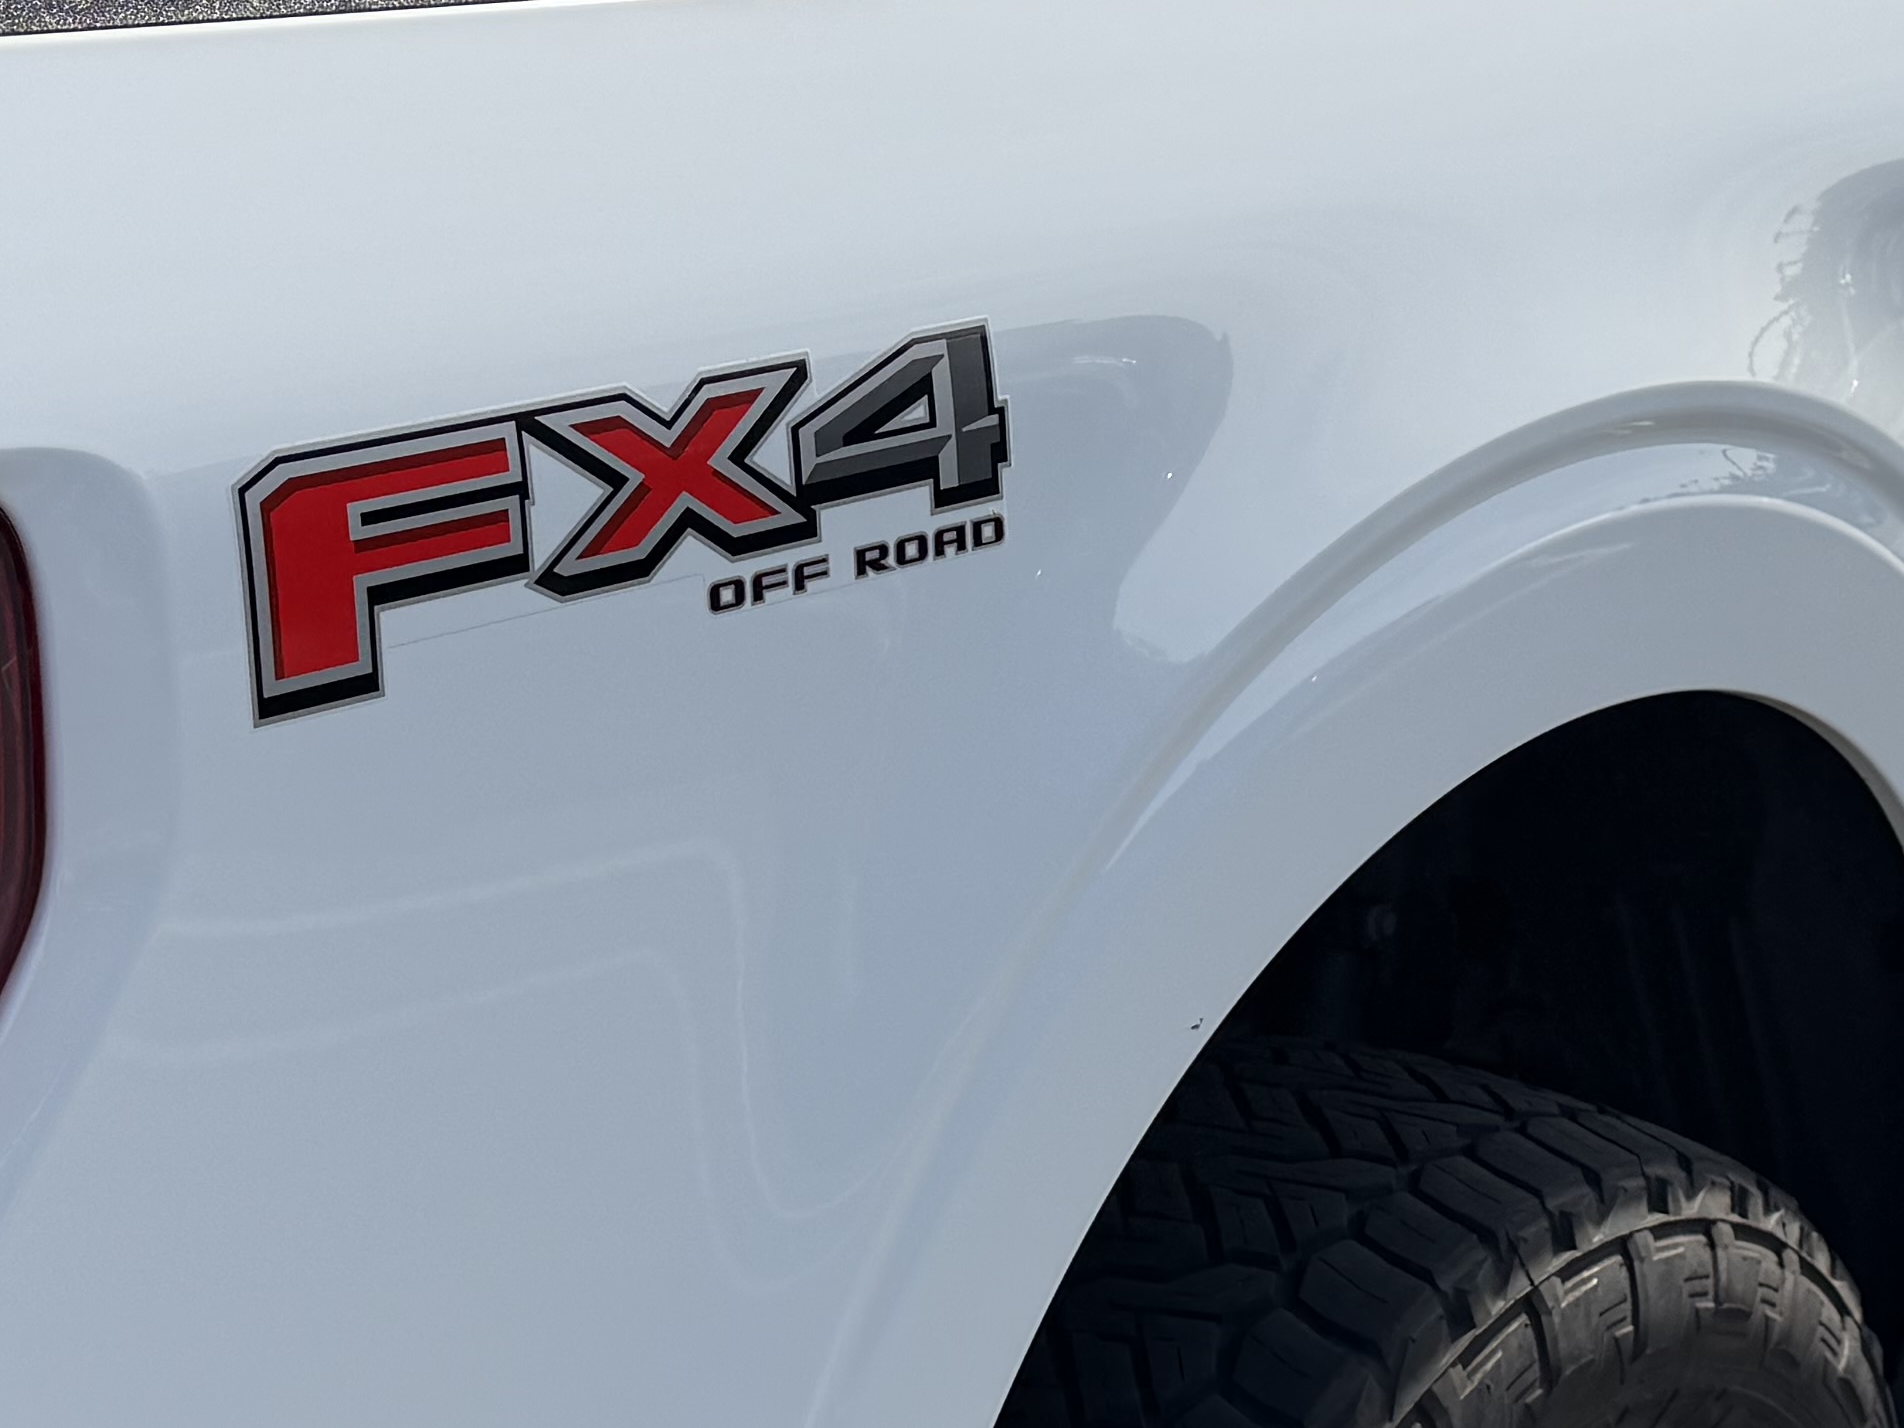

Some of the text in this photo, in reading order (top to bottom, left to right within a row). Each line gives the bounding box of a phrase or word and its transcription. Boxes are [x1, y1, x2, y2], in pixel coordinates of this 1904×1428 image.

[232, 320, 1011, 727] FX4
[708, 511, 1006, 615] OFF ROAD
